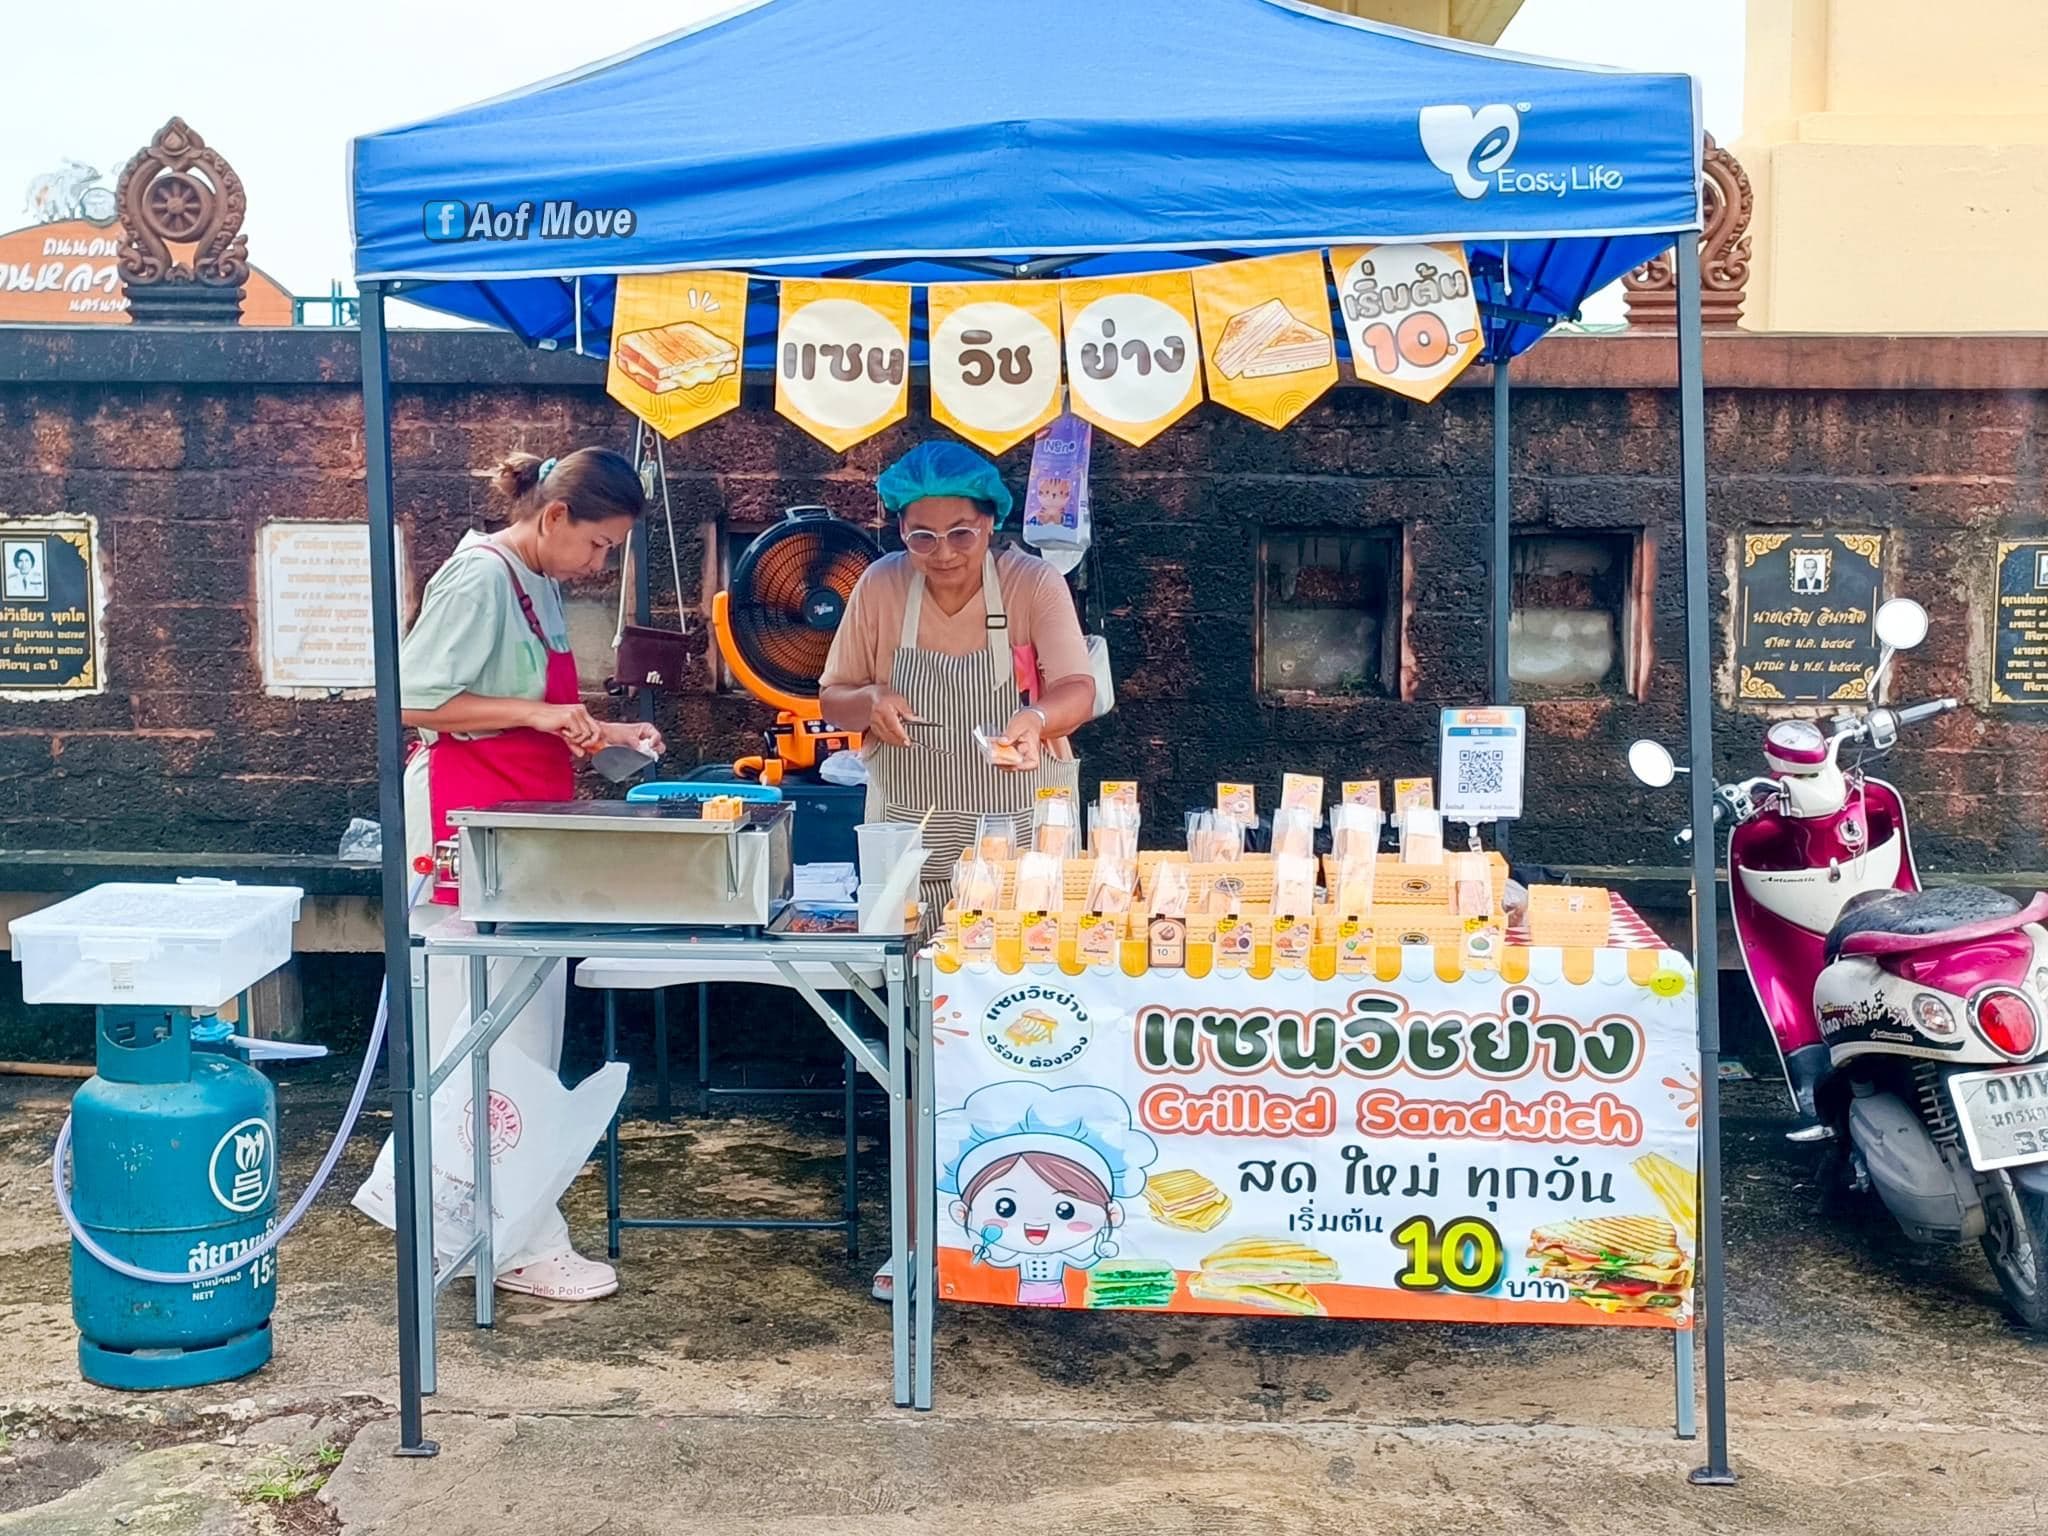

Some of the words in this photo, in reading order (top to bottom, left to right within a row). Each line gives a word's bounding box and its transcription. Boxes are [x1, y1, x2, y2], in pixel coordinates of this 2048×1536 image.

[1498, 168, 1568, 199] Easy
[1571, 165, 1624, 191] Life
[1343, 259, 1469, 321] เริ่มต้น
[783, 341, 905, 386] แซน
[957, 329, 1033, 386] วิช
[1080, 318, 1186, 381] ย่าง
[986, 985, 1088, 1022] แซนวิชย่าง
[986, 1034, 1024, 1065] อร่อย
[1029, 1036, 1088, 1068] ต้องลอง
[1142, 991, 1639, 1078] แซนวิชย่าง
[1145, 1088, 1332, 1134] Grilled
[1359, 1092, 1639, 1142] Sandwich
[1238, 1158, 1317, 1194] สด
[1340, 1145, 1440, 1197] ใหม่
[1468, 1155, 1616, 1213] ทุกวัน
[1289, 1199, 1384, 1233] เริ่มต้น
[1394, 1217, 1499, 1290] 10
[1505, 1278, 1566, 1299] บาท
[558, 1285, 585, 1296] Polo
